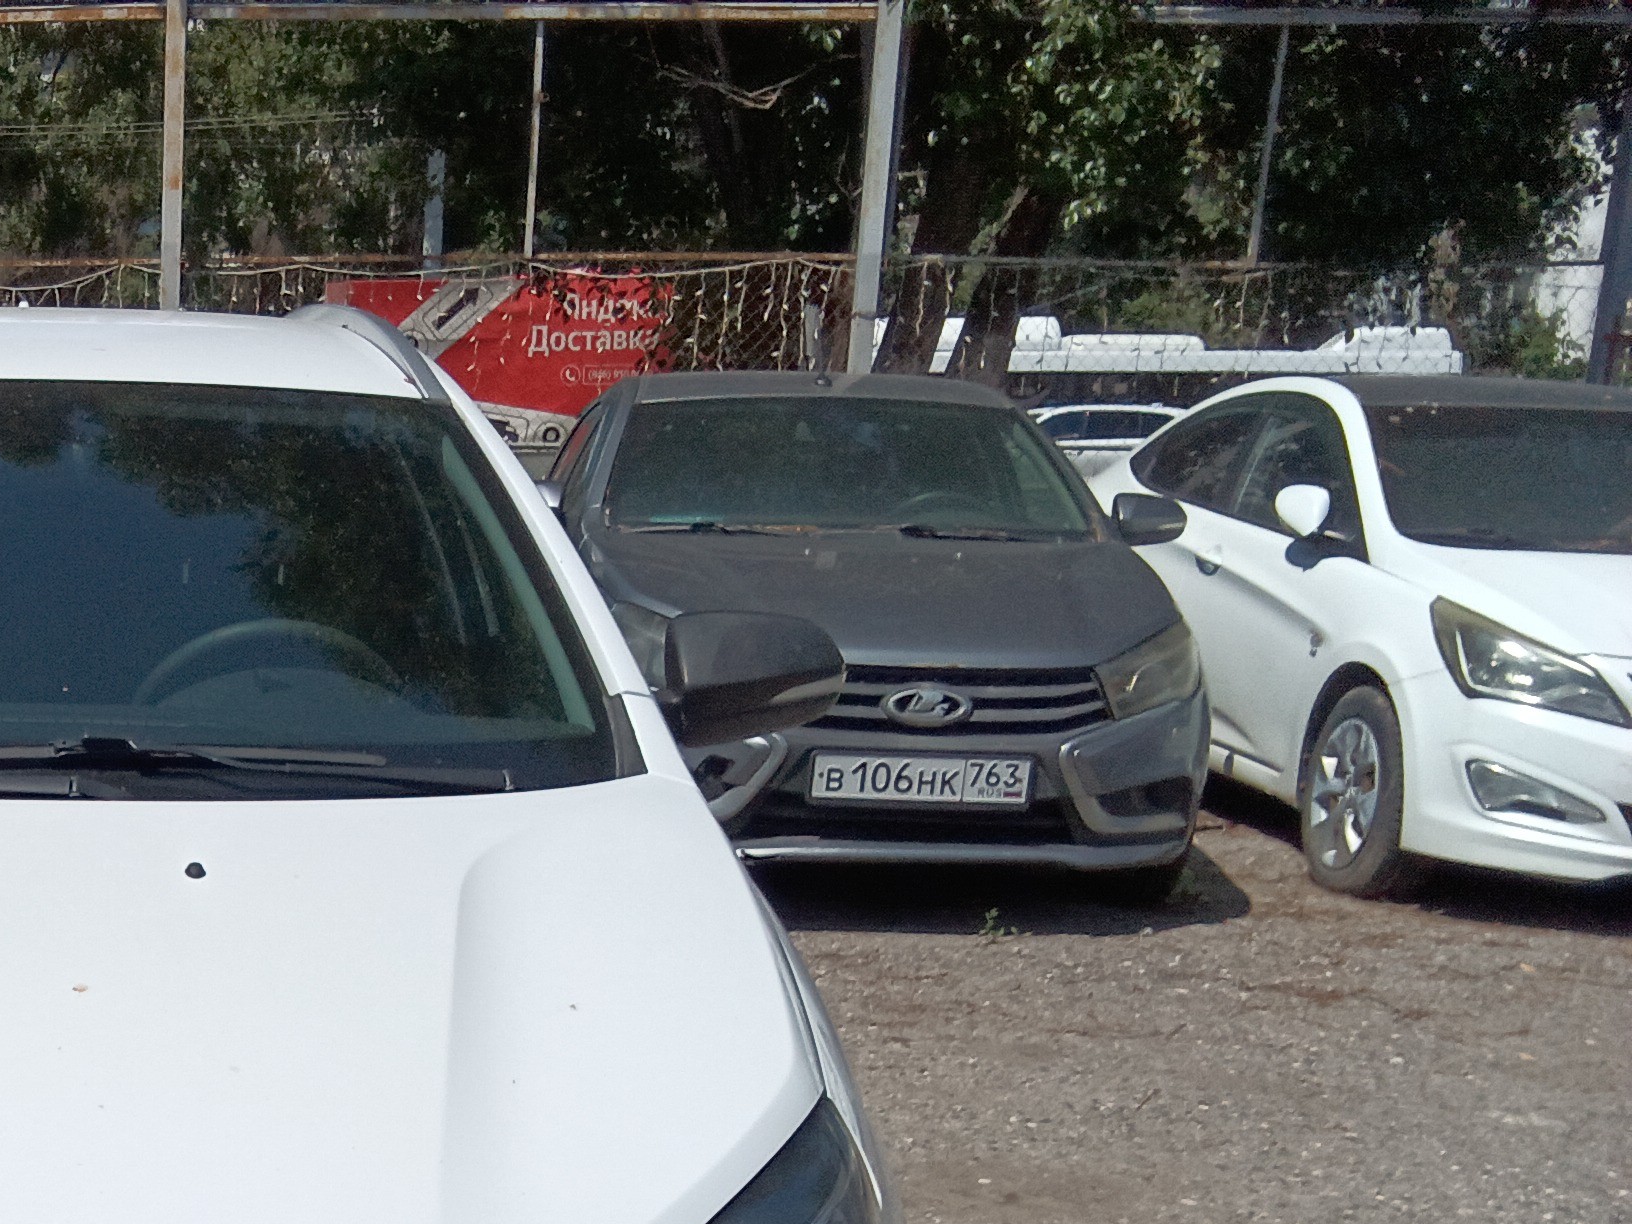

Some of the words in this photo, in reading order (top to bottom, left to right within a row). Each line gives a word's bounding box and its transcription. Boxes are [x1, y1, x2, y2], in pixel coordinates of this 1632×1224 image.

[527, 325, 660, 358] Доставка
[968, 763, 1020, 788] 763
[977, 787, 1002, 798] RUS
